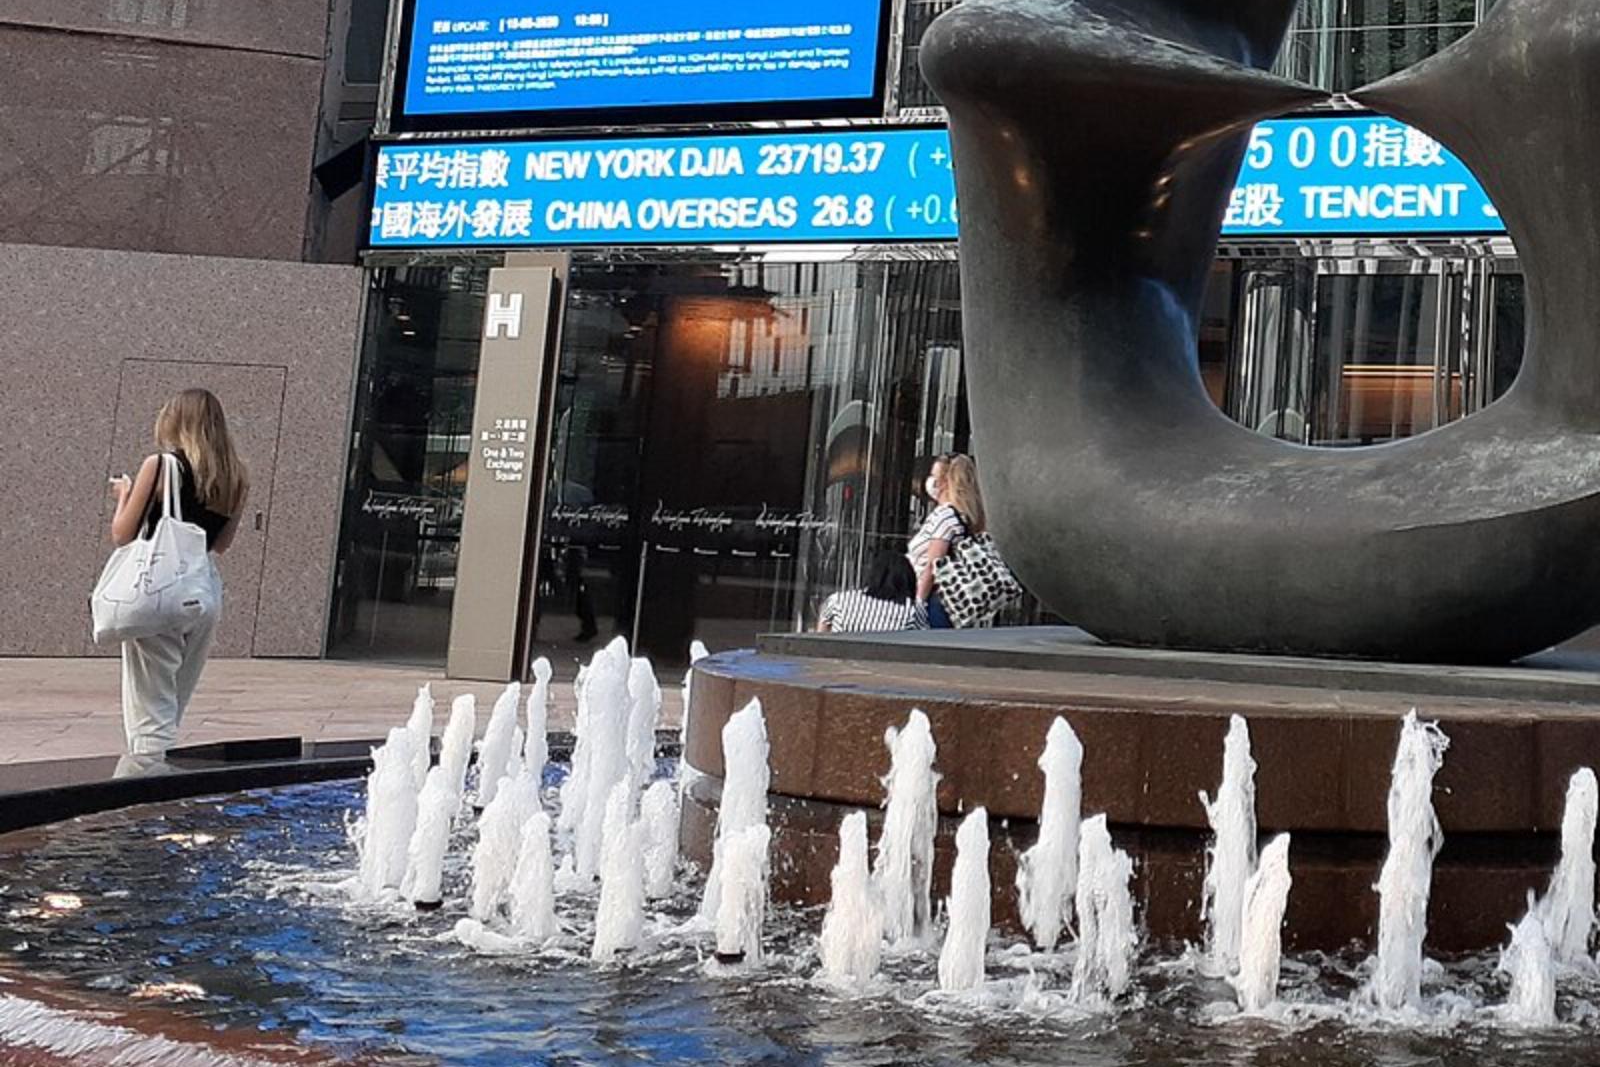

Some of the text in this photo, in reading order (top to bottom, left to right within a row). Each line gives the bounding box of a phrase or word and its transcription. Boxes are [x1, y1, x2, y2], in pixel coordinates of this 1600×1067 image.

[524, 148, 592, 181] NEW
[596, 148, 674, 181] YORK
[678, 145, 744, 179] DJIA
[756, 139, 887, 176] 23719.37
[544, 196, 632, 231] CHINA
[637, 194, 799, 229] OVERSEAS
[810, 193, 875, 228] 26.8
[1299, 183, 1468, 219] TENCENT
[485, 292, 523, 339] H
